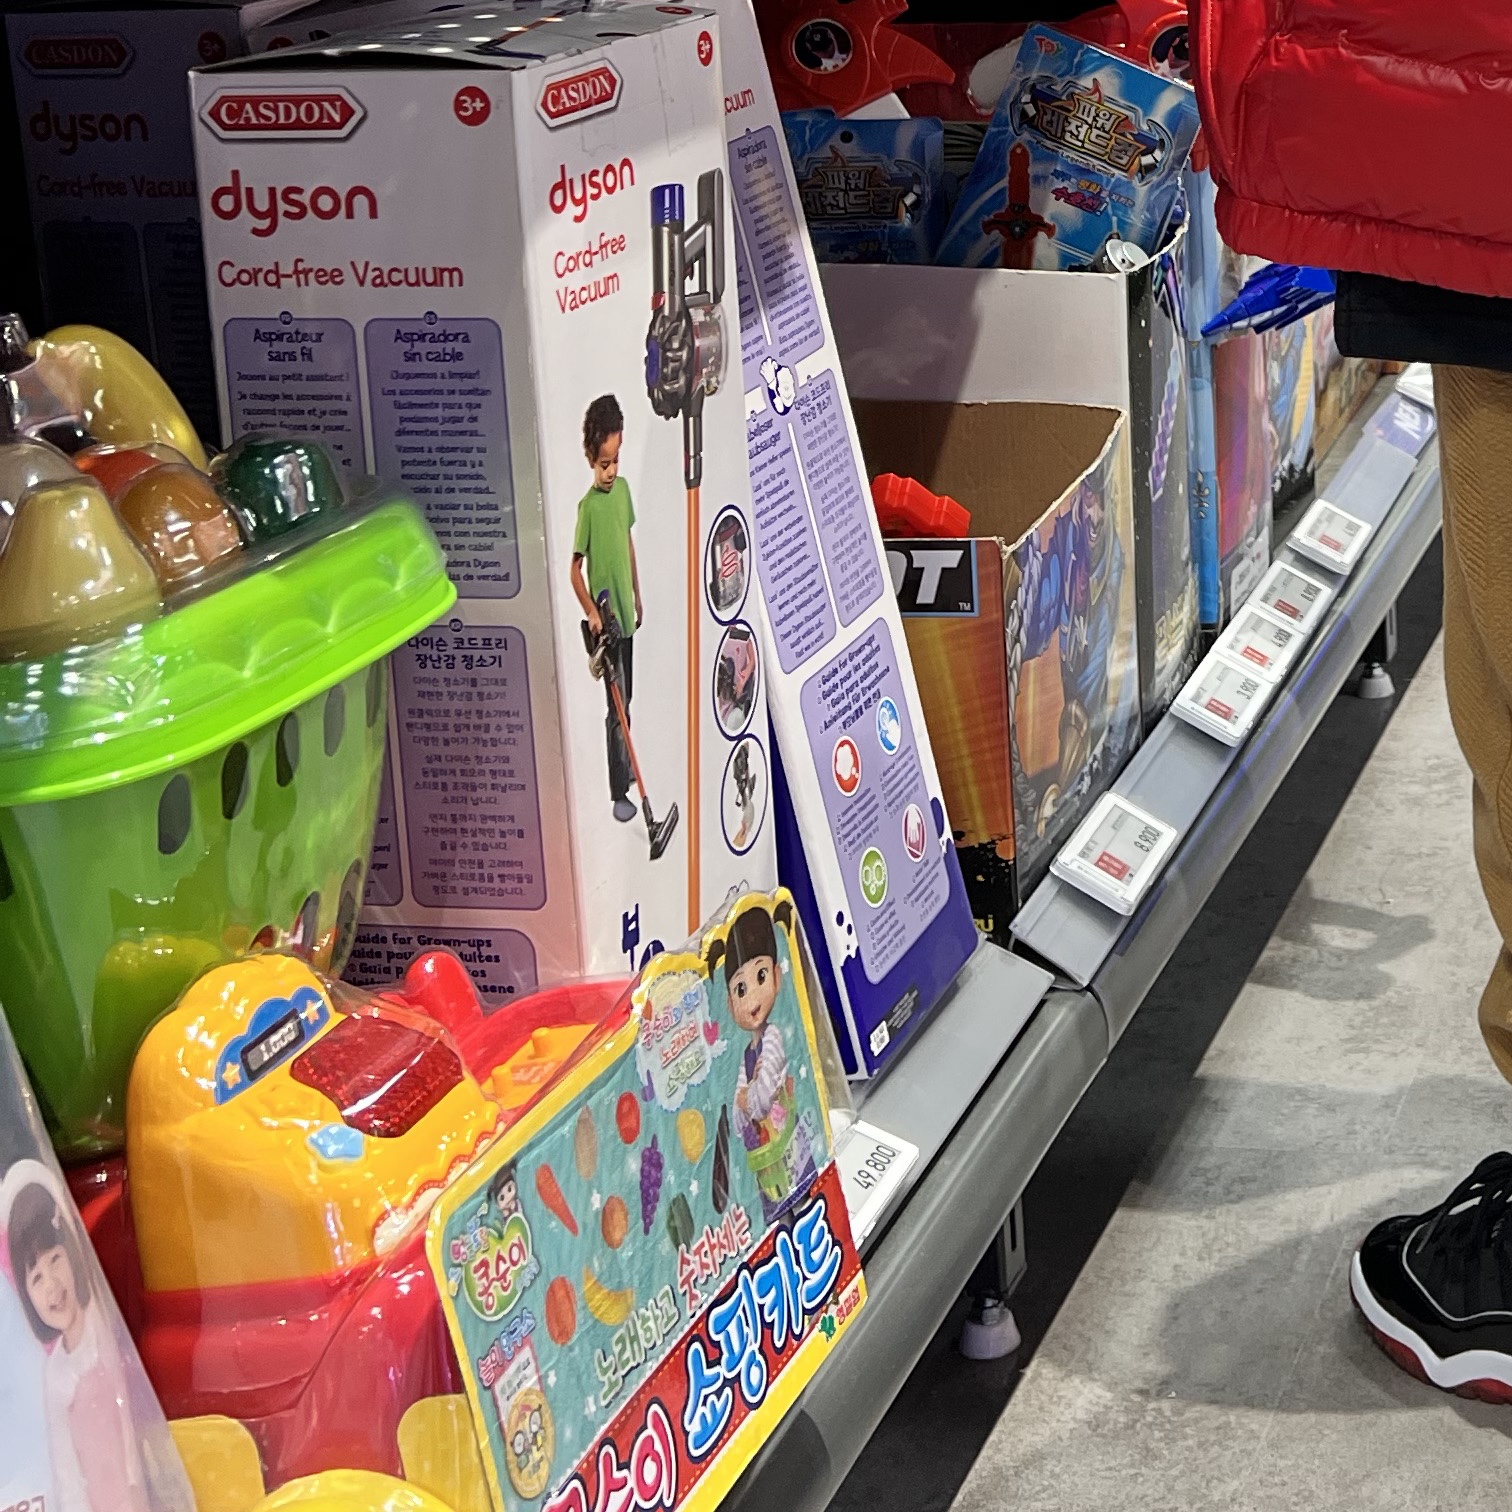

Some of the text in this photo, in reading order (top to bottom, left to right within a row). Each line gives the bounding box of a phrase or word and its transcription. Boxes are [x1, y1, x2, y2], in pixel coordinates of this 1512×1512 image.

[32, 42, 120, 66] CASDON
[546, 40, 712, 114] CASDON 3+
[219, 94, 486, 126] CASDON 3+
[724, 87, 756, 116] cuum
[29, 100, 150, 157] dyson
[1078, 103, 1115, 132] 파워
[131, 174, 197, 198] Vacuu
[548, 157, 636, 224] dyson
[825, 170, 867, 191] 파워
[210, 168, 379, 238] dyson
[553, 231, 627, 280] Cord-free
[217, 258, 465, 289] Cord-free Vacuum
[555, 271, 621, 316] Vacuum
[253, 328, 325, 347] Aspirateur
[394, 329, 472, 351] Aspiradora
[268, 346, 314, 362] sans fil
[404, 347, 465, 363] sin cable
[407, 637, 509, 652] 다이손 코드프리
[415, 654, 503, 670] 장난감 청소기
[351, 948, 382, 959] uide
[392, 933, 413, 946] for
[417, 934, 493, 951] Grown-ups
[677, 1204, 752, 1312] 숫자세는
[473, 1236, 527, 1313] 콩순이
[685, 1198, 843, 1458] 쇼핑카트
[595, 1285, 680, 1407] 노래하고
